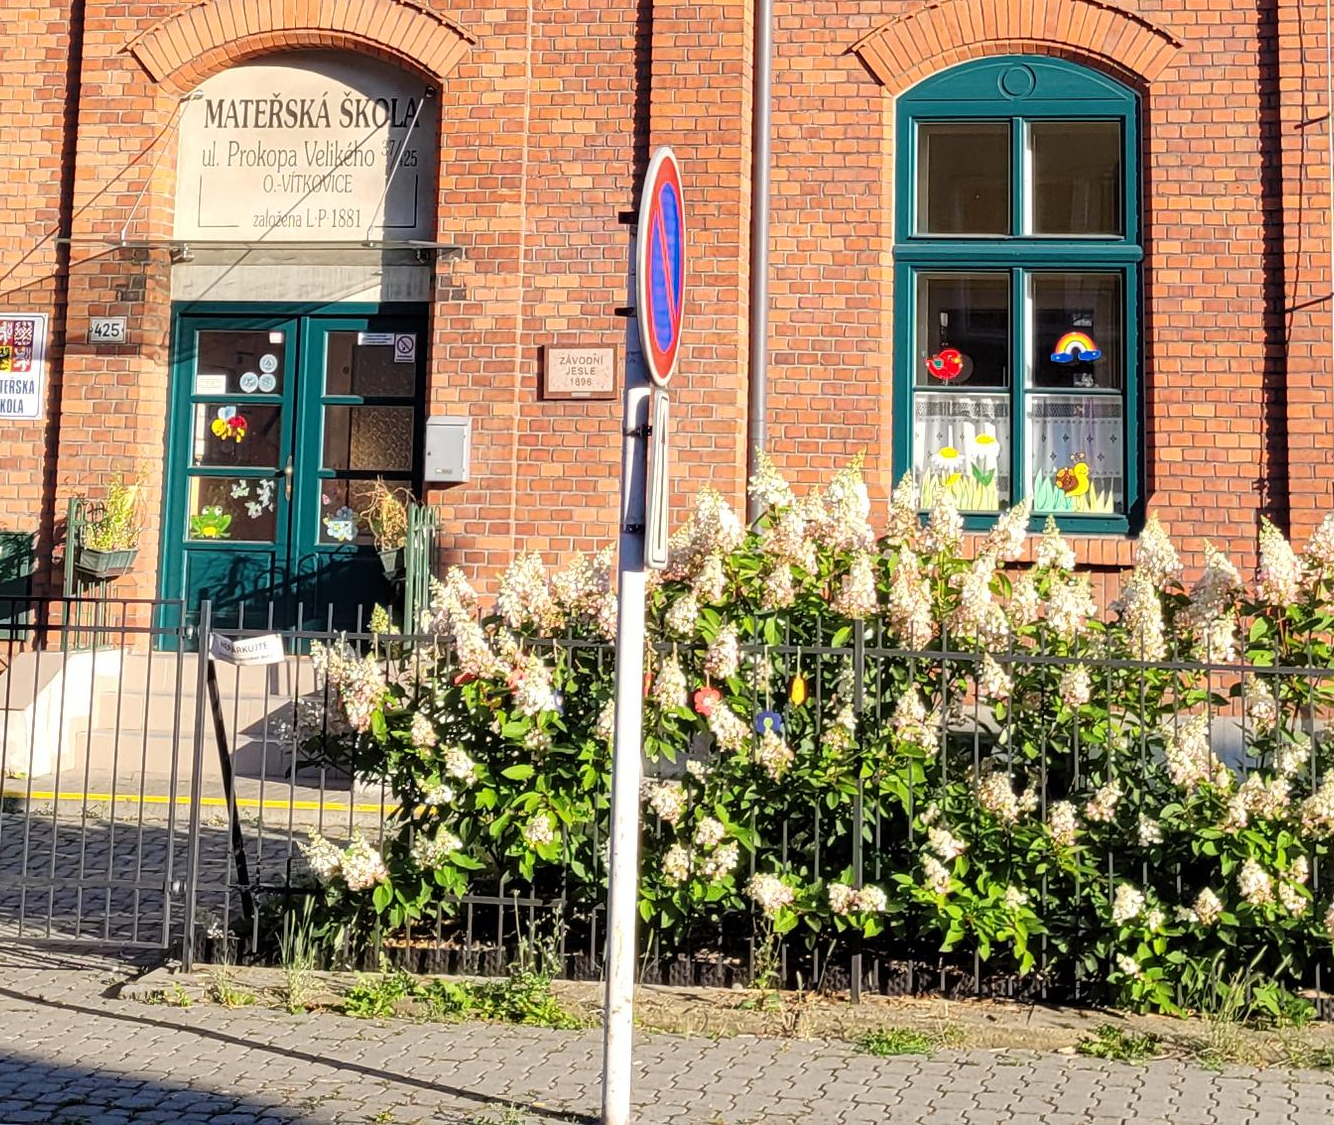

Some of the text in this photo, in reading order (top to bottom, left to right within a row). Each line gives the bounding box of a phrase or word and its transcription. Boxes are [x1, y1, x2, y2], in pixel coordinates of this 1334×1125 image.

[204, 91, 420, 129] MATEŘSKÁ ŠKOLA
[202, 140, 418, 173] ul. Prokopa Velikého 37/25
[253, 208, 302, 228] založena
[94, 323, 120, 337] 425
[566, 367, 596, 375] JESLE
[570, 377, 593, 386] 1896
